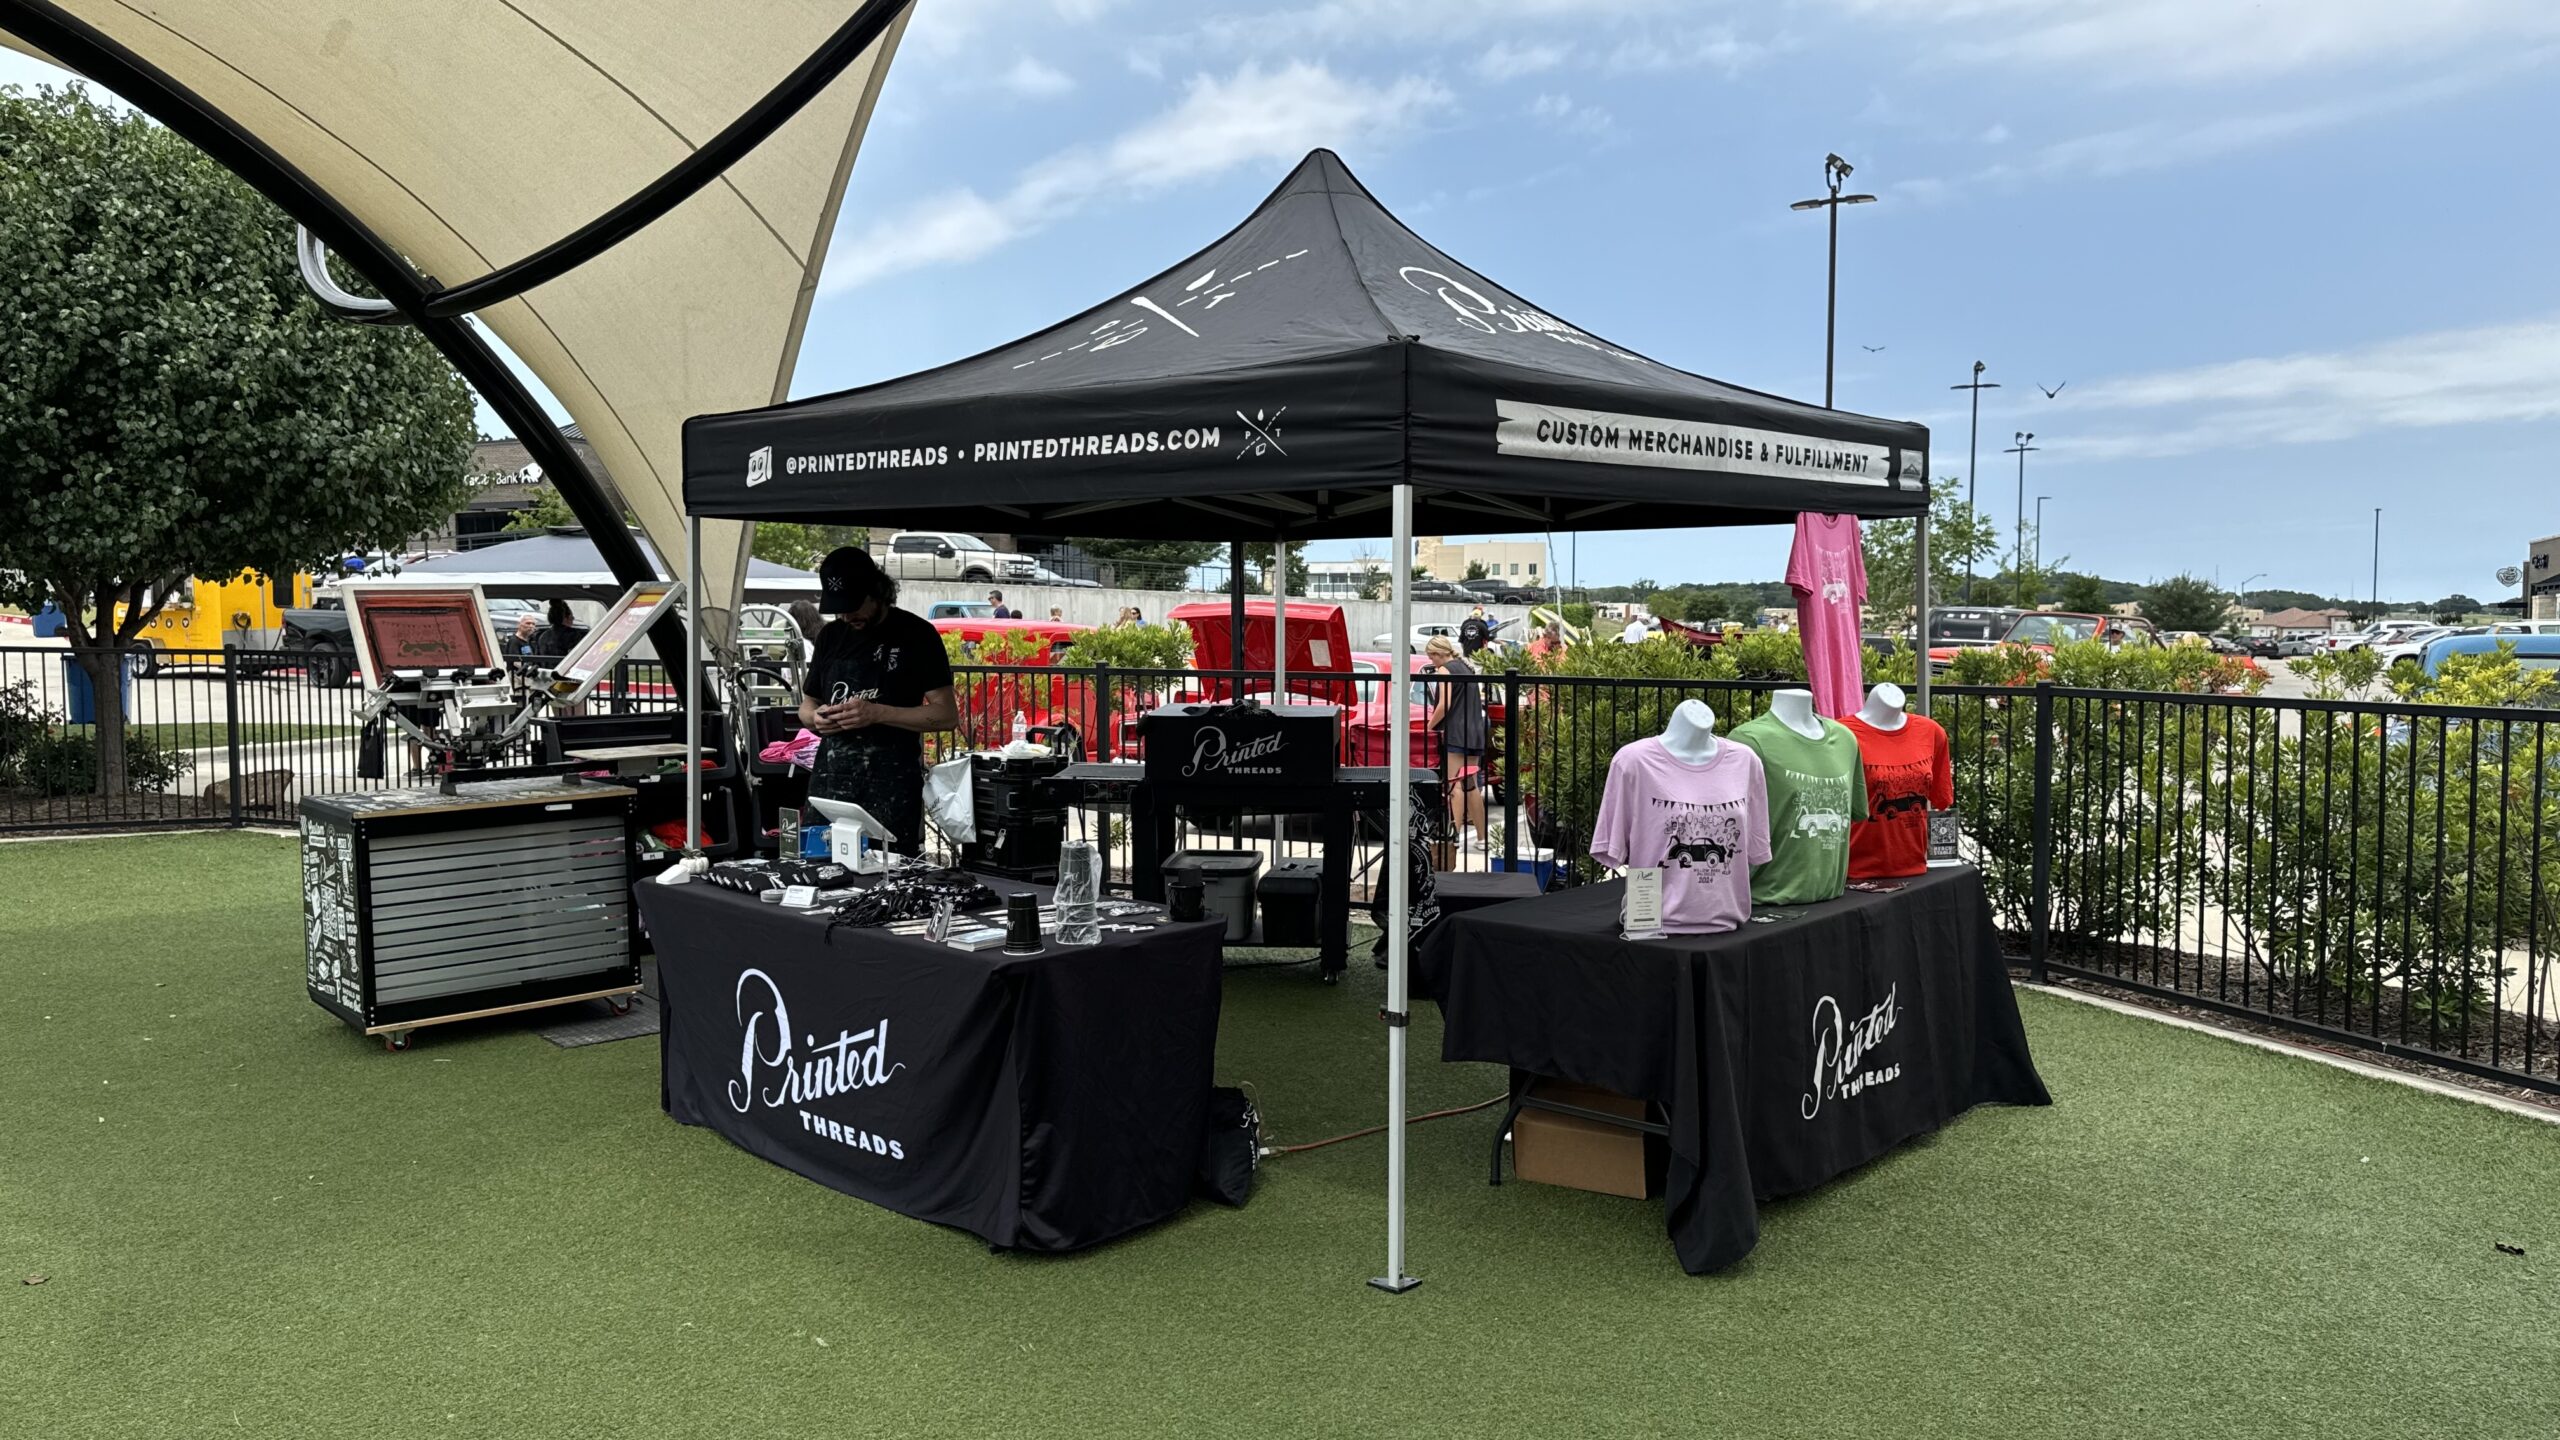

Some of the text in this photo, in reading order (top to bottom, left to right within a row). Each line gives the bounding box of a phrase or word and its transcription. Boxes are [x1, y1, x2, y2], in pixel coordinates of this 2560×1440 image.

[1400, 266, 1588, 337] Print
[786, 427, 1221, 475] @PRINTEDTHREADS PRINTEDTHREADS.COM
[1244, 428, 1281, 440] P T
[1536, 419, 1869, 473] CUSTOM MERCHANDISE & FULFILLMENT
[1181, 725, 1290, 777] Printed
[1226, 766, 1282, 774] THREADS
[728, 968, 906, 1113] Printed
[799, 1109, 905, 1160] THREADS
